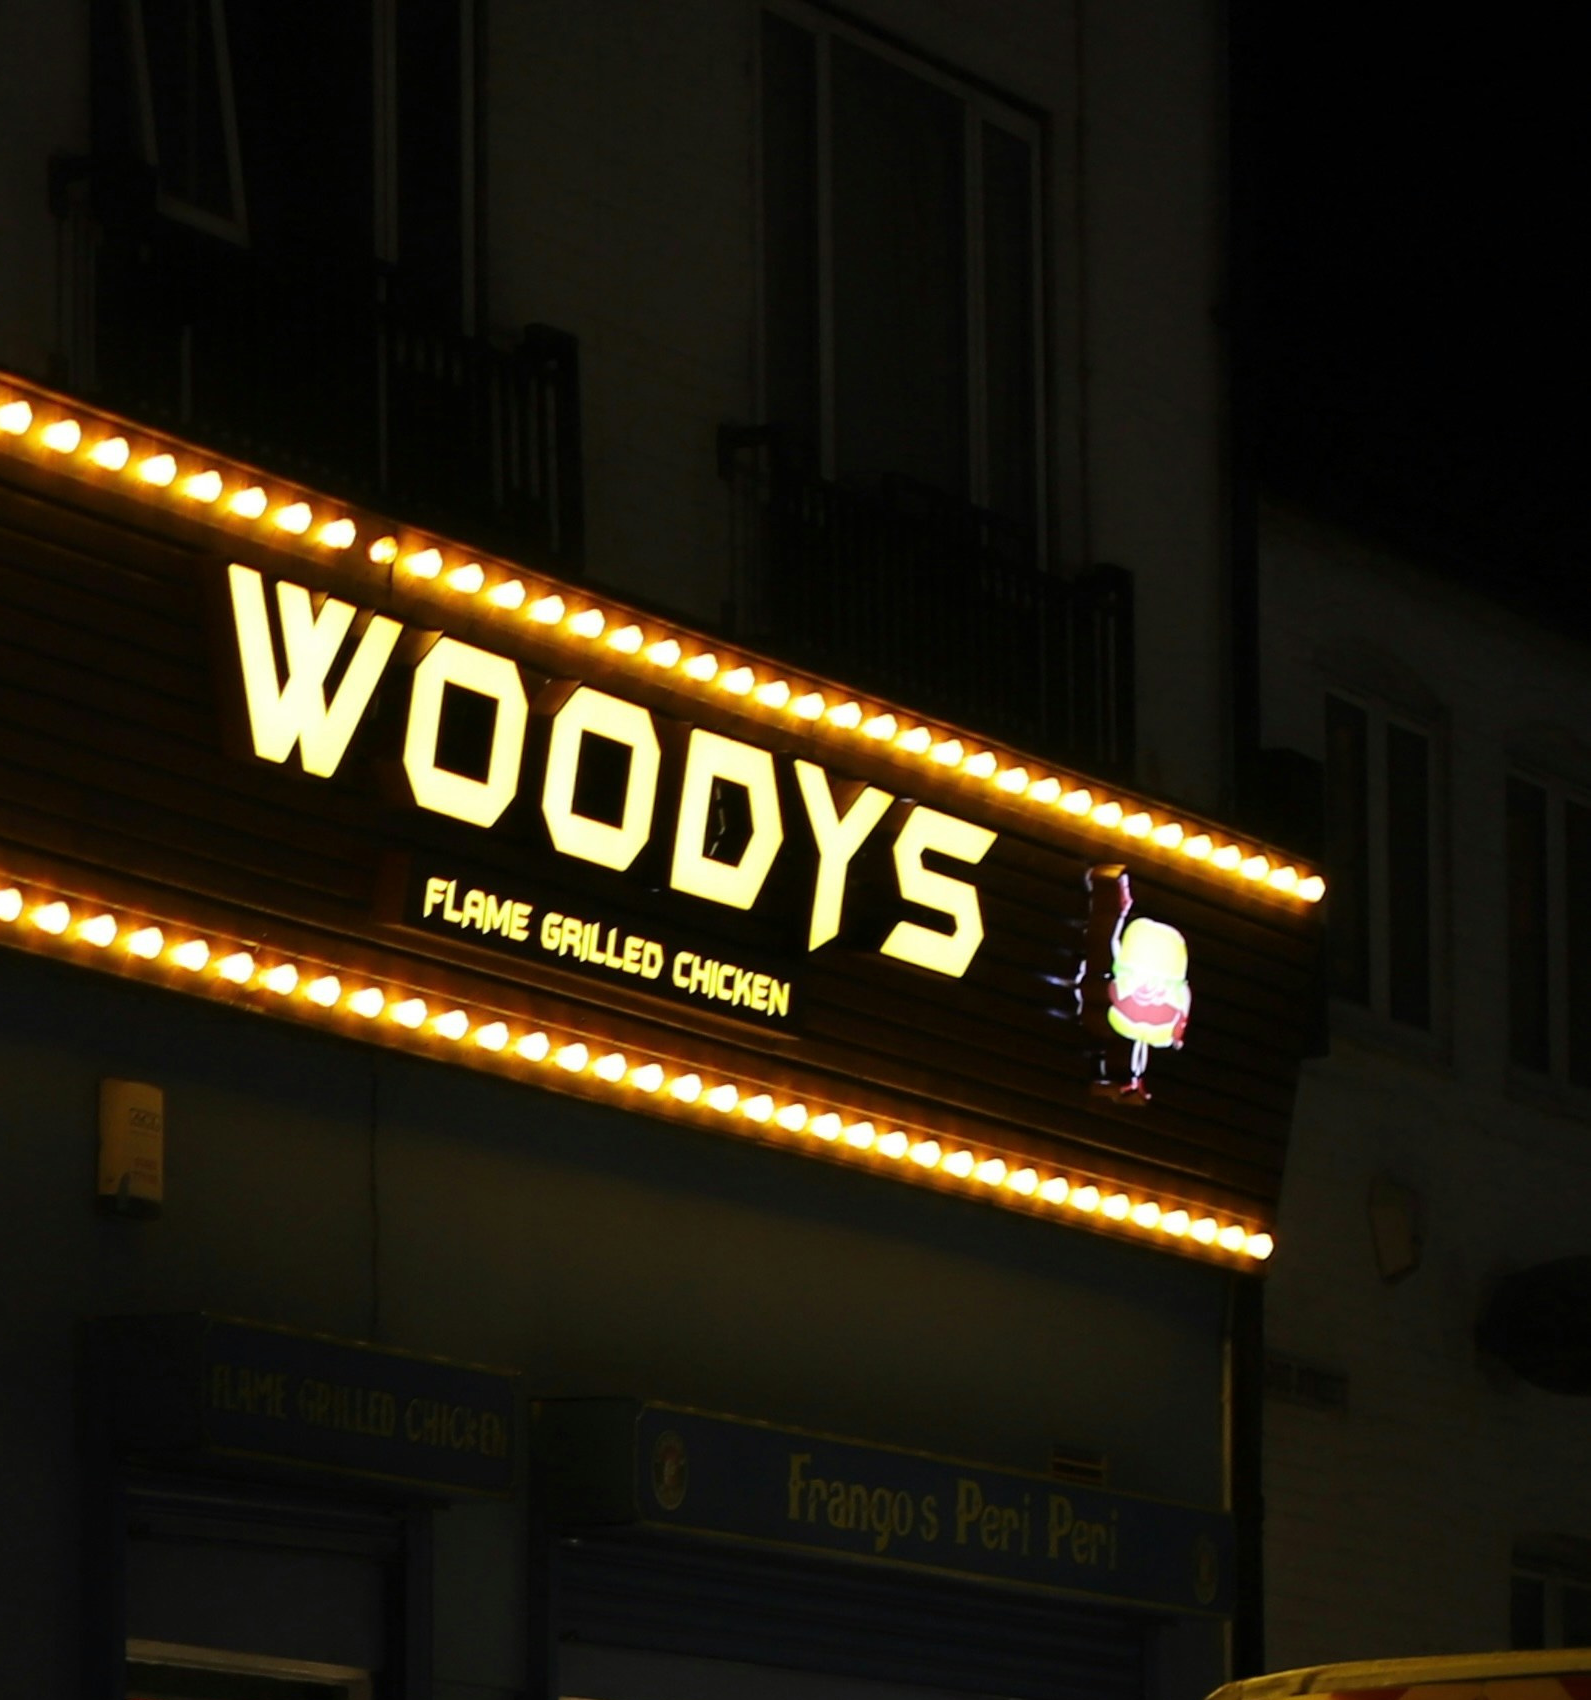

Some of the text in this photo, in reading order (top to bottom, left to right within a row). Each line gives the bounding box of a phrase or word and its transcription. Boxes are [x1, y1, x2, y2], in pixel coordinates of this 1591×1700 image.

[227, 562, 999, 979] WOODYS
[422, 876, 791, 1018] FLAME GRILLED CHICKEN
[403, 1397, 510, 1458] CHICKEN
[954, 1477, 1032, 1556] Peri
[1046, 1492, 1120, 1571] Peri
